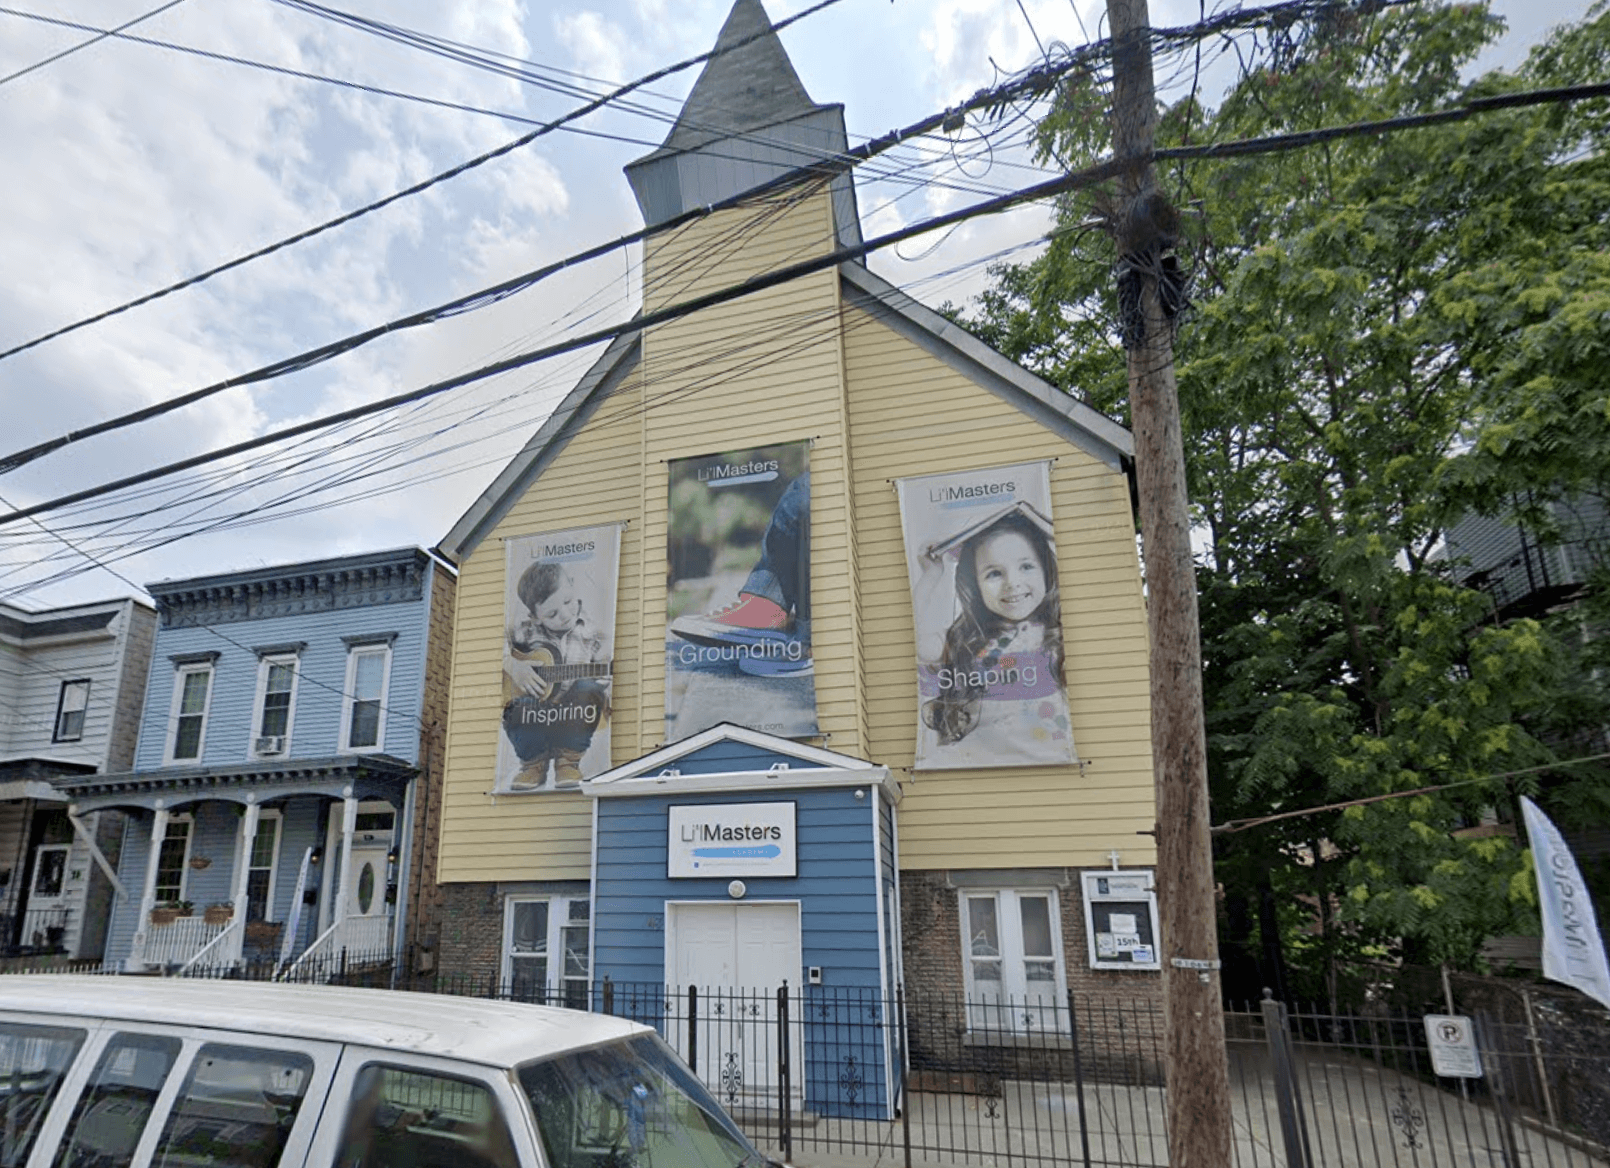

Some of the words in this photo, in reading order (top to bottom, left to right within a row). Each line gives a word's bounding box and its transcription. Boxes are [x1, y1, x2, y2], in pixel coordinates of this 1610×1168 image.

[698, 460, 779, 481] Li'lMasters
[930, 481, 1016, 502] Li'lMasters
[531, 541, 595, 558] Li'lMasters
[679, 639, 802, 664] Grounding
[937, 666, 1038, 689] Shaping
[521, 703, 597, 725] Inspiring
[681, 824, 782, 842] Li'lMasters
